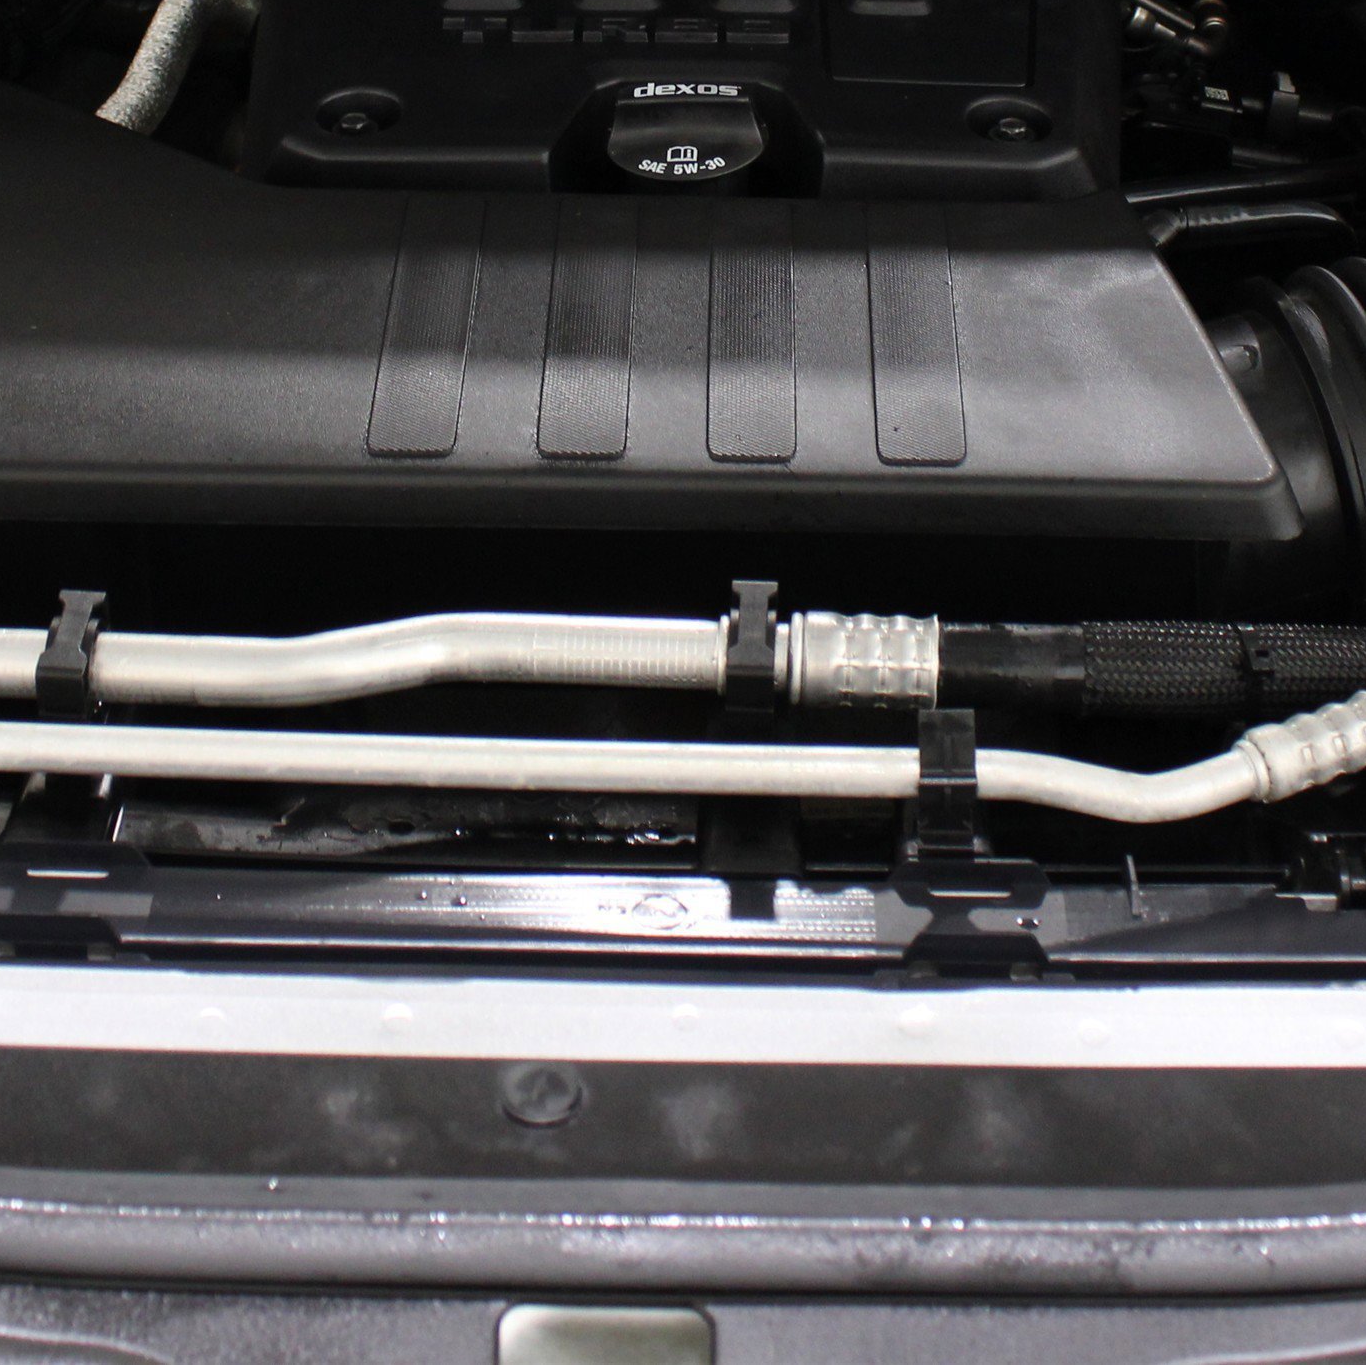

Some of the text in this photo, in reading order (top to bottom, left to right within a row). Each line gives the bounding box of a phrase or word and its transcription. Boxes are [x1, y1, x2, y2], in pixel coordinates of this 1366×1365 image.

[633, 82, 739, 98] dexos
[638, 157, 726, 175] SAE 5W-30
